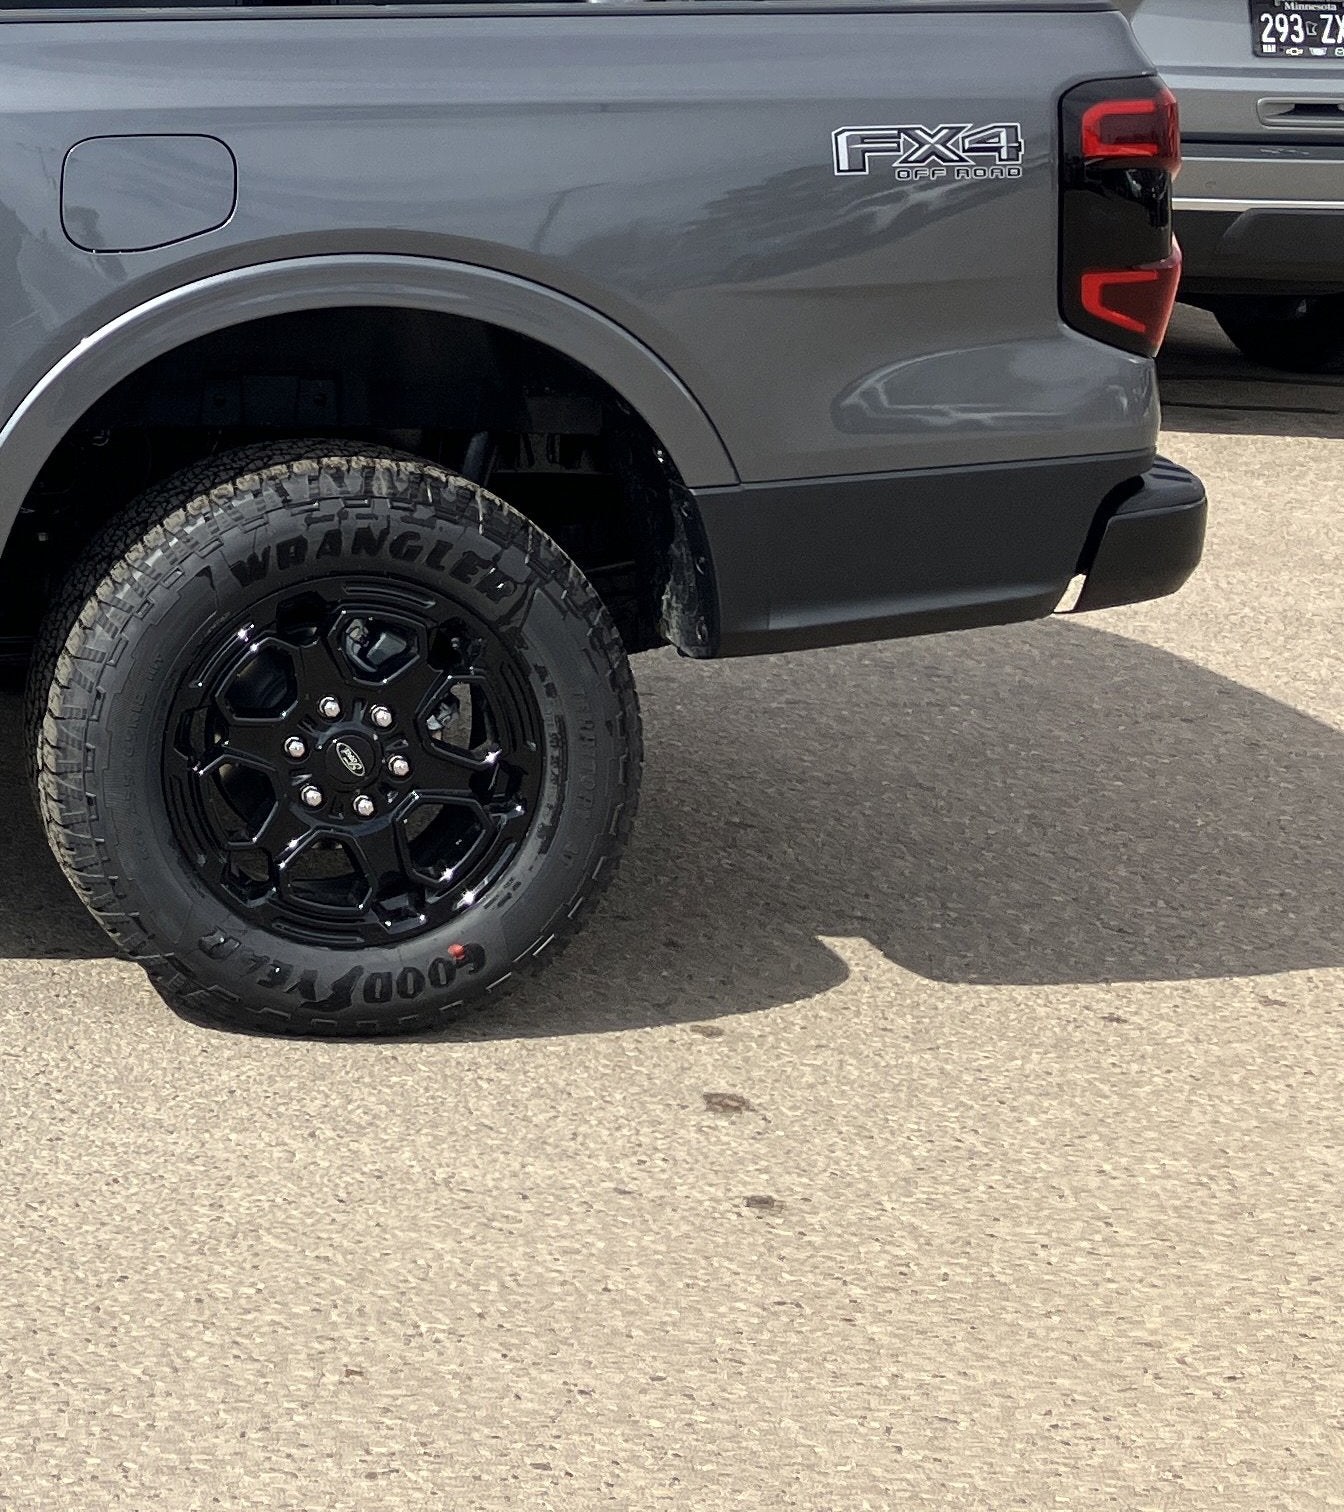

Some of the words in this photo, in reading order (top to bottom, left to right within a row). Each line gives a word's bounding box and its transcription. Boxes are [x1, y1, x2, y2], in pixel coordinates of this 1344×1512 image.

[1260, 12, 1305, 44] 293
[1284, 1, 1338, 12] Minnesota
[831, 122, 1025, 176] FX4
[895, 167, 947, 181] OFF
[954, 166, 1023, 180] ROAD
[229, 525, 516, 604] WRANGLER
[198, 925, 487, 1013] GOODYEAR
